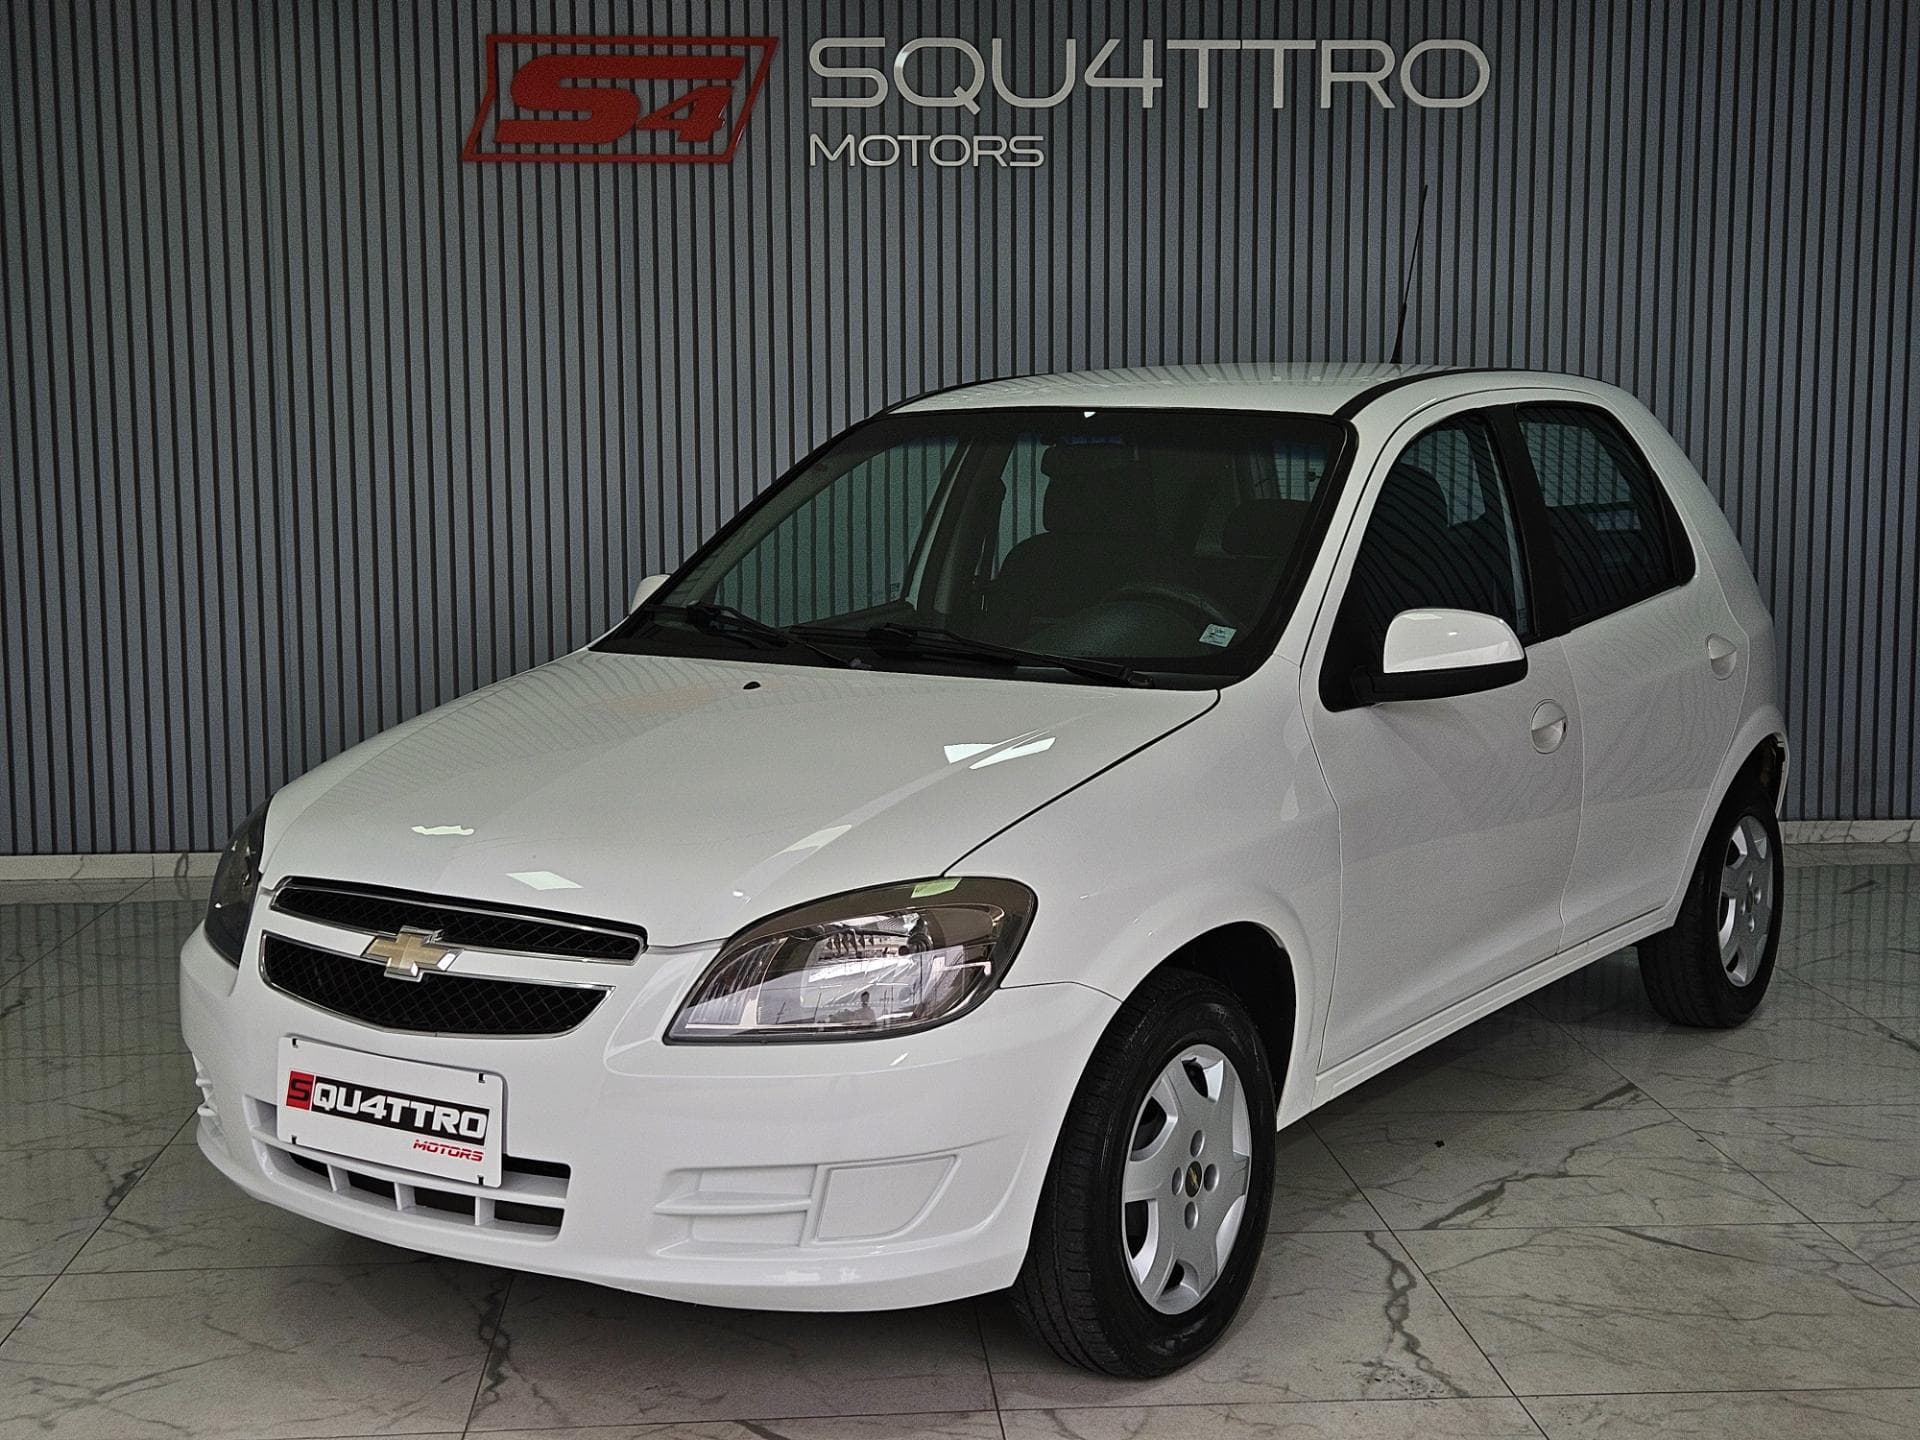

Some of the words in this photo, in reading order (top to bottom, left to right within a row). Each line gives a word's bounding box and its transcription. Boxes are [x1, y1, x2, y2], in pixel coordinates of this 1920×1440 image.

[494, 54, 745, 144] S4
[809, 37, 1490, 115] SQU4TTRO
[809, 133, 1045, 167] MOTORS
[287, 1076, 488, 1139] SQU4TTRO
[413, 1139, 484, 1162] MOTORS
